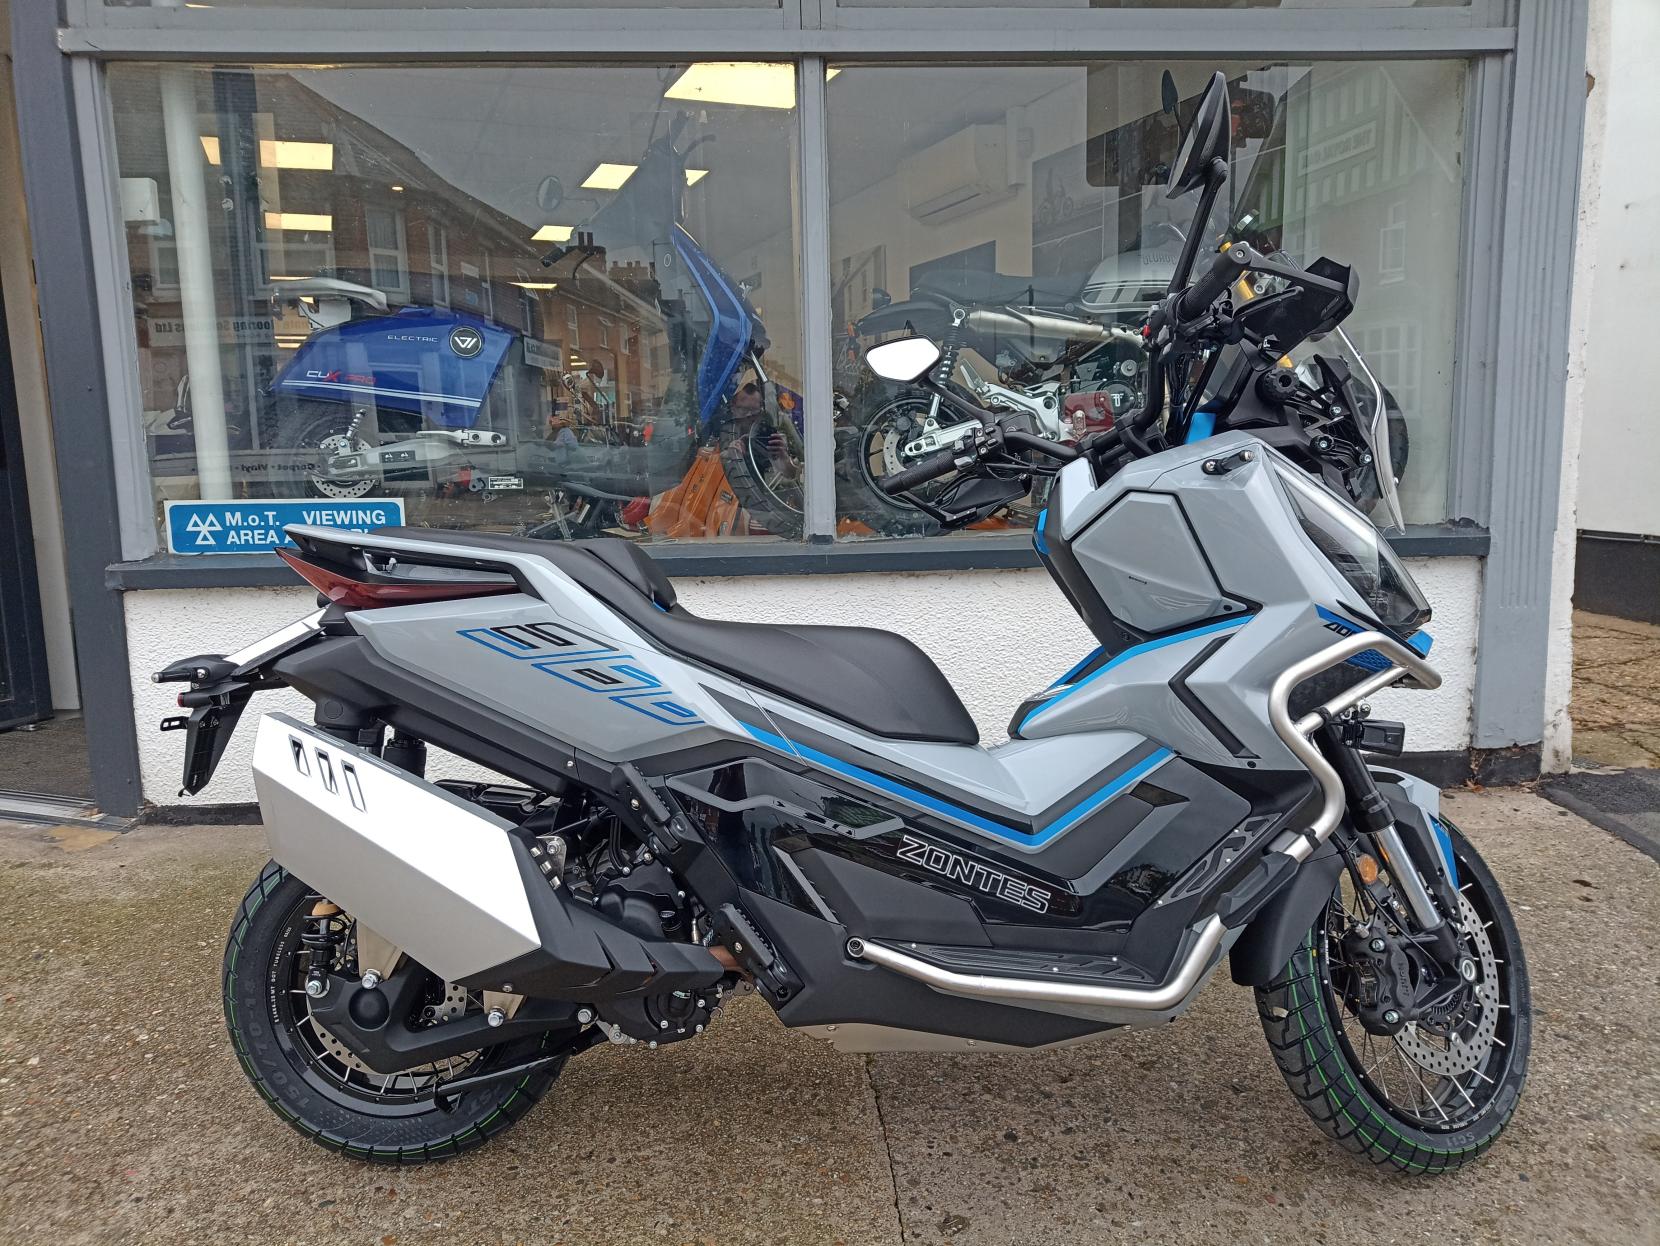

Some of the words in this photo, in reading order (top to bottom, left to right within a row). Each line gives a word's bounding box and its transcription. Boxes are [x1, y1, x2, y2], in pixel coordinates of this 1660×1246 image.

[387, 335, 439, 343] ELECTRIC
[306, 370, 342, 383] CUX
[225, 511, 280, 526] M.o.T.
[302, 510, 386, 525] VIEWING
[227, 529, 280, 545] AREA
[897, 834, 1052, 914] ZONTES
